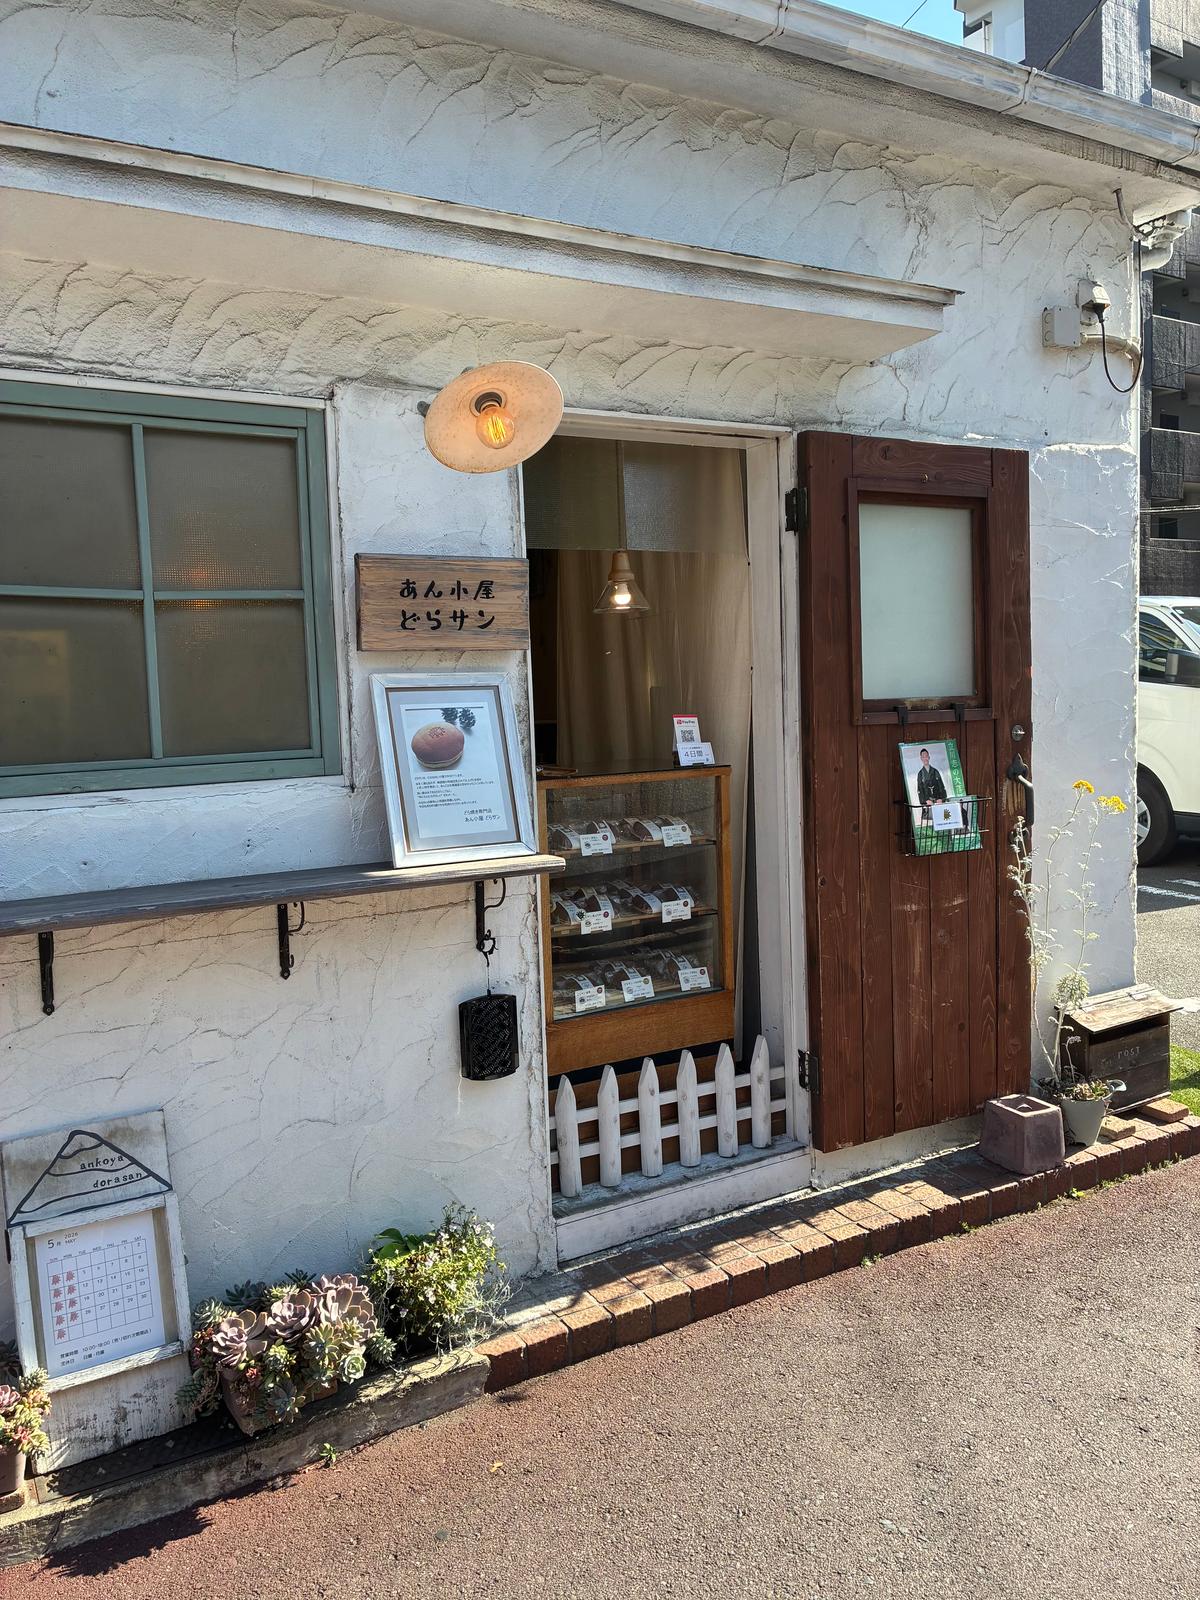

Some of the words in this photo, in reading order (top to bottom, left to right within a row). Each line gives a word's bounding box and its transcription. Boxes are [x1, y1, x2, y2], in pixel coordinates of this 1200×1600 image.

[400, 579, 495, 600] あん小屋
[400, 609, 495, 631] どらサン
[80, 1155, 124, 1170] ankoya
[93, 1172, 142, 1188] dorasan
